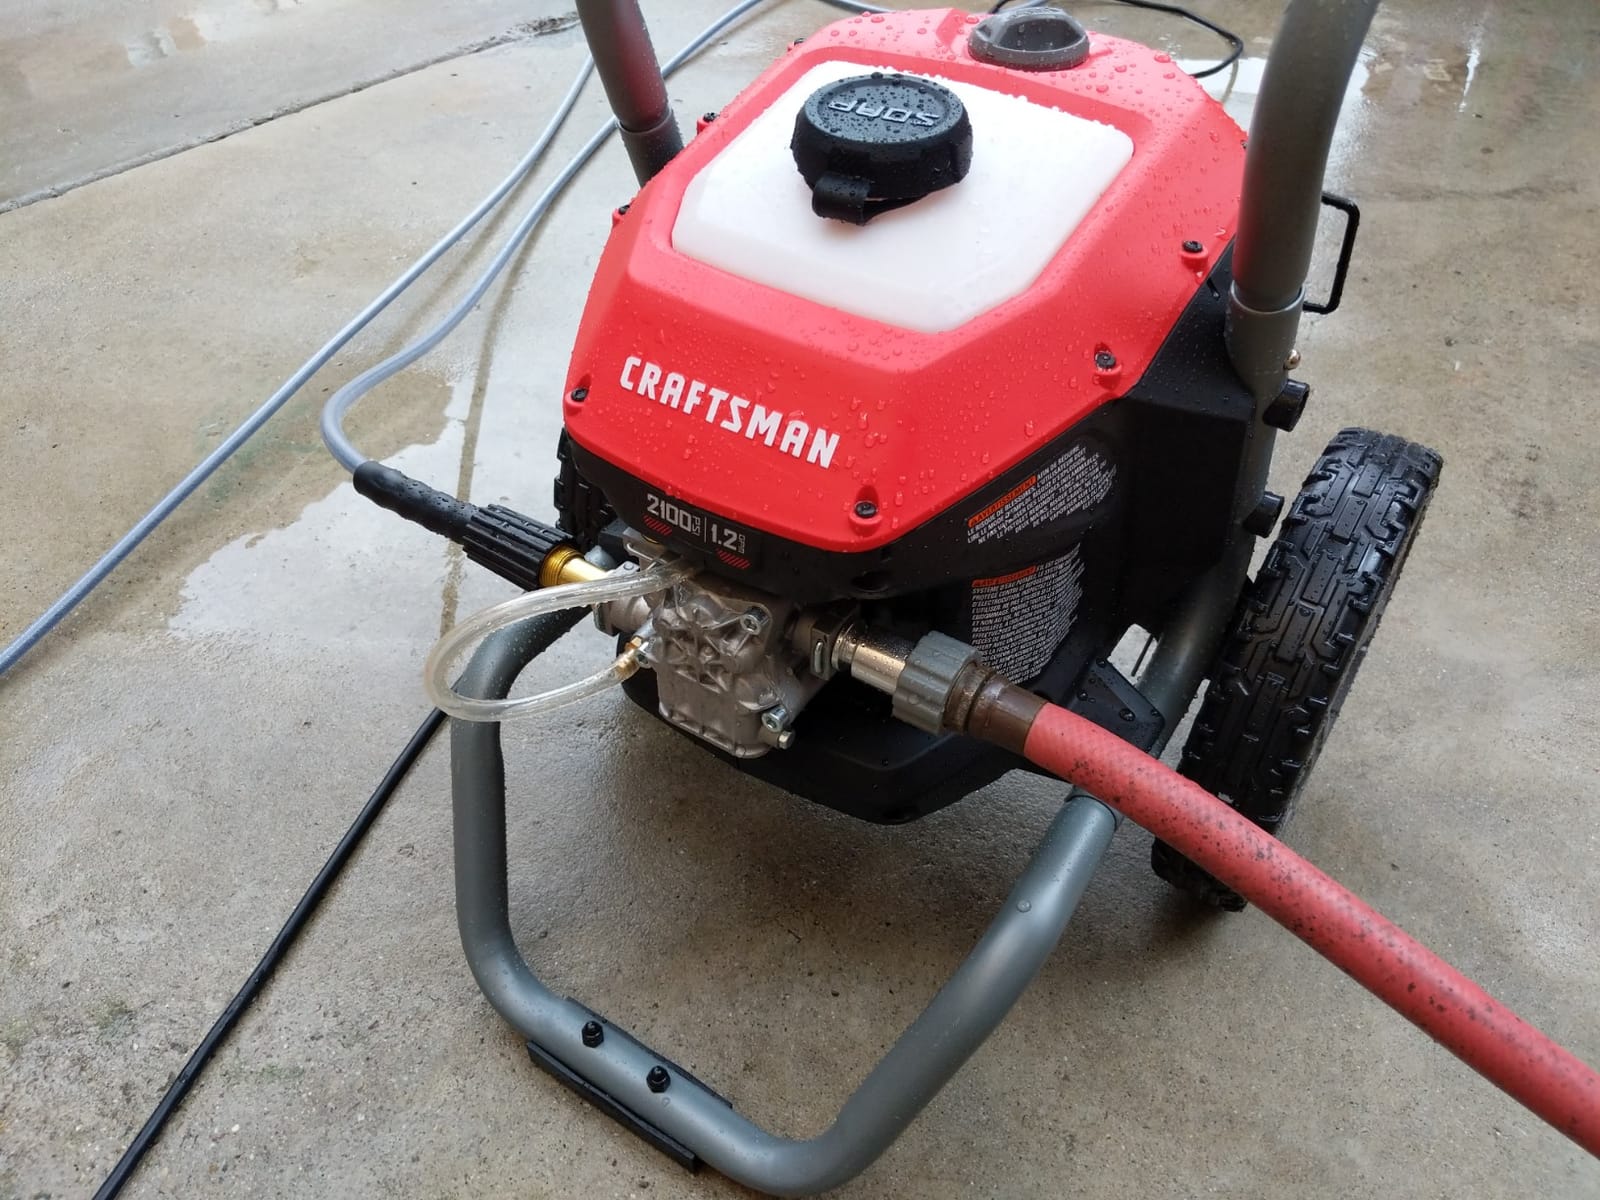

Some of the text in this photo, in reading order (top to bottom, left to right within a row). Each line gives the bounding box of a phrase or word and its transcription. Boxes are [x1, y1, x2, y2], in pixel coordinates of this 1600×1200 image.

[828, 100, 940, 128] SOAP
[619, 356, 841, 469] CRAFTSMAN
[646, 493, 700, 536] 2100 PSI
[712, 524, 738, 550] 1.2
